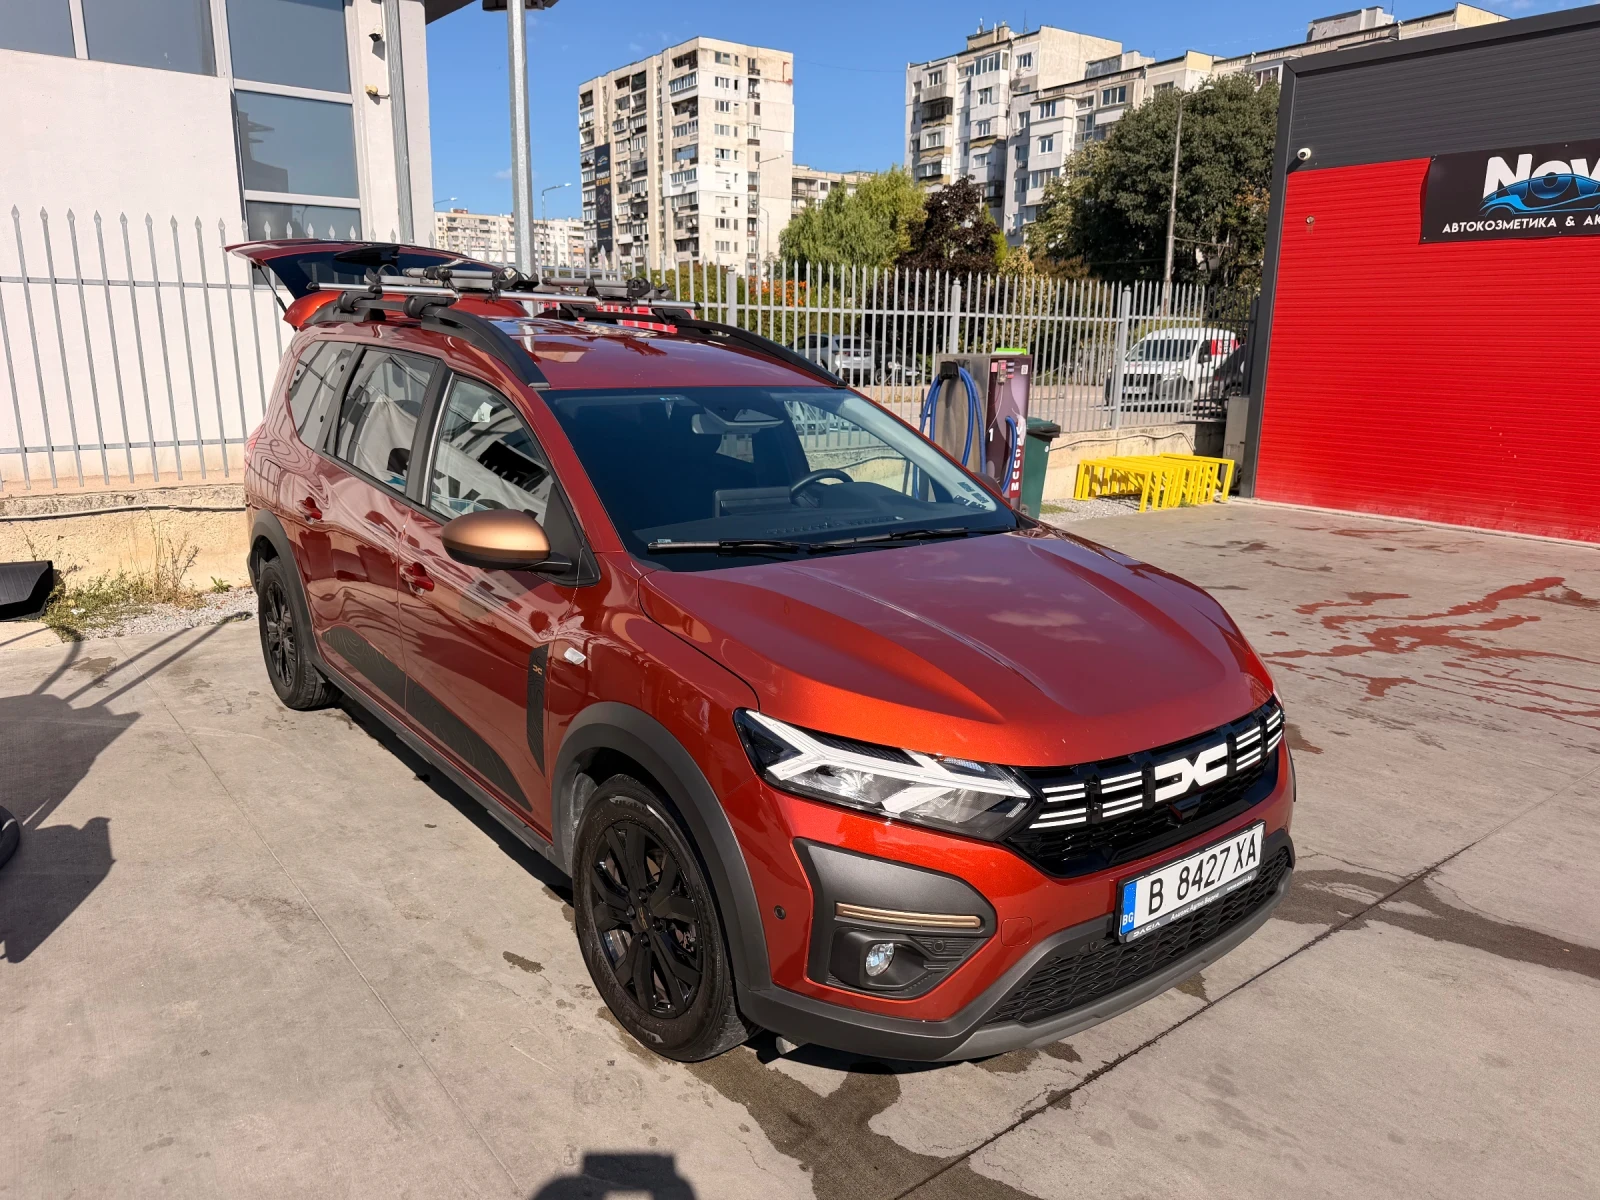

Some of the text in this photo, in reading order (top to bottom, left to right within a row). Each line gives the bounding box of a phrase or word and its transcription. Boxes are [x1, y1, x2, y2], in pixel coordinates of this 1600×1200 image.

[1442, 217, 1557, 234] АВТОКОЗМЕТИКА
[1565, 215, 1576, 227] &
[1177, 846, 1231, 900] 8427
[1233, 833, 1256, 873] XA
[1122, 912, 1134, 926] BG
